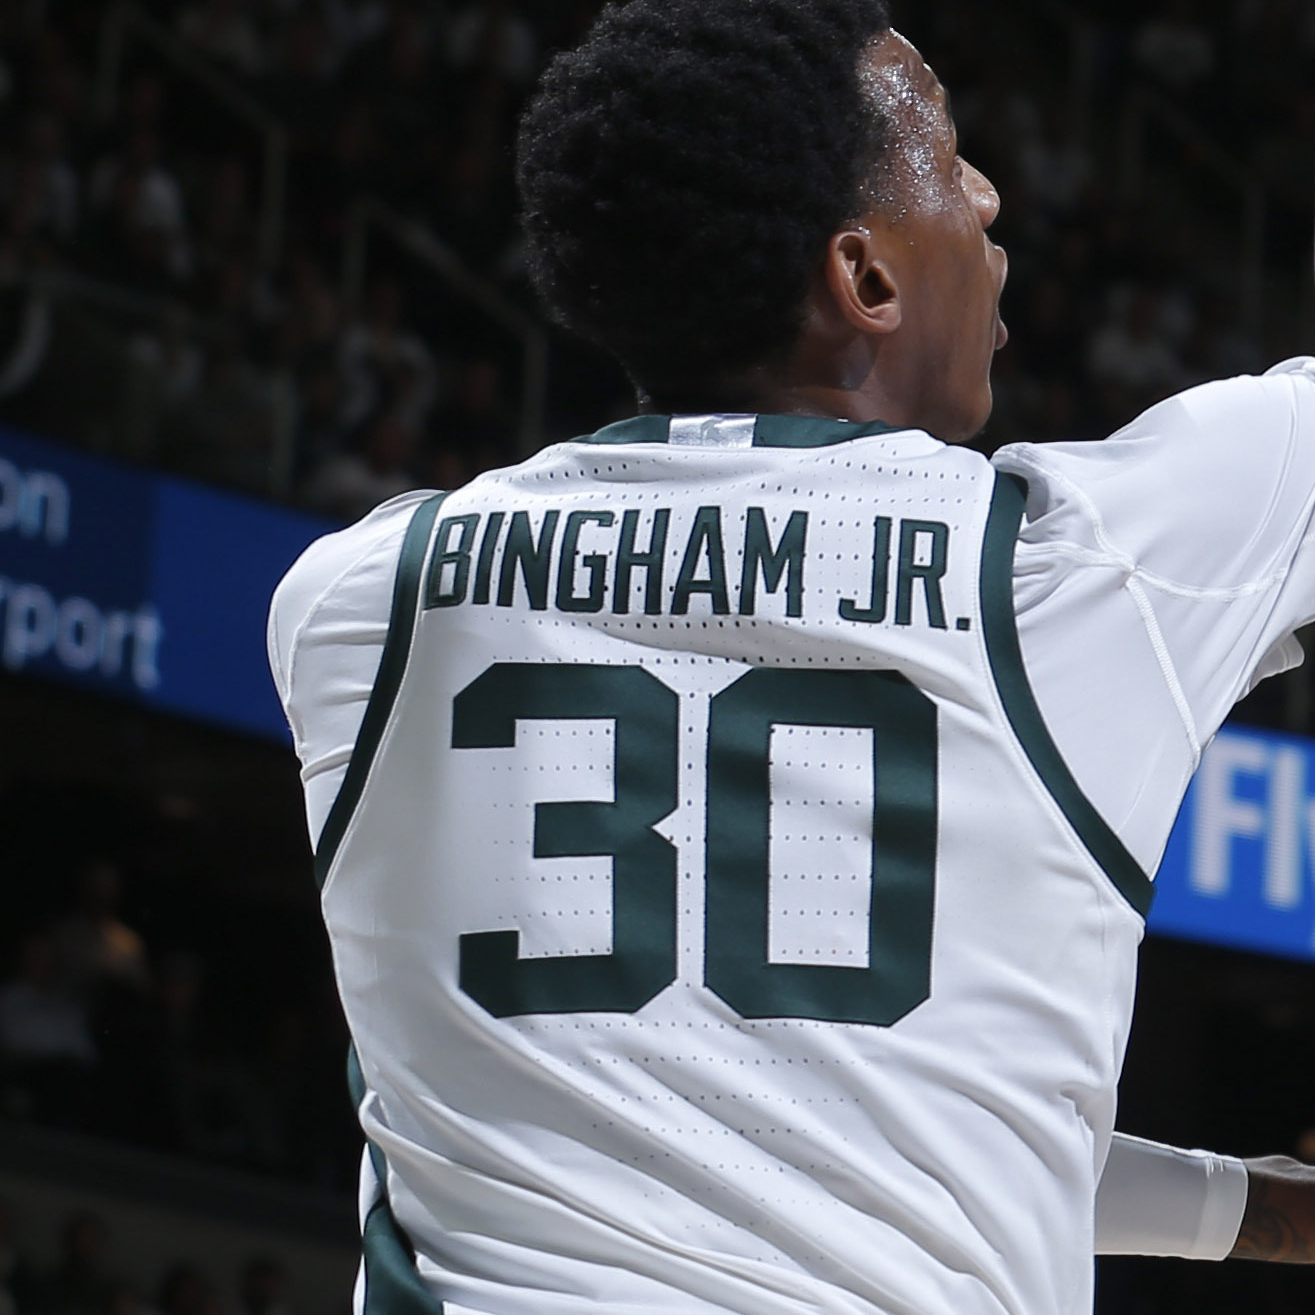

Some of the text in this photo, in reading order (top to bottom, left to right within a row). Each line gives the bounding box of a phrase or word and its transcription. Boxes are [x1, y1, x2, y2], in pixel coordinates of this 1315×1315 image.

[423, 505, 971, 631] BINGHAM JR.
[450, 662, 938, 1028] 30
